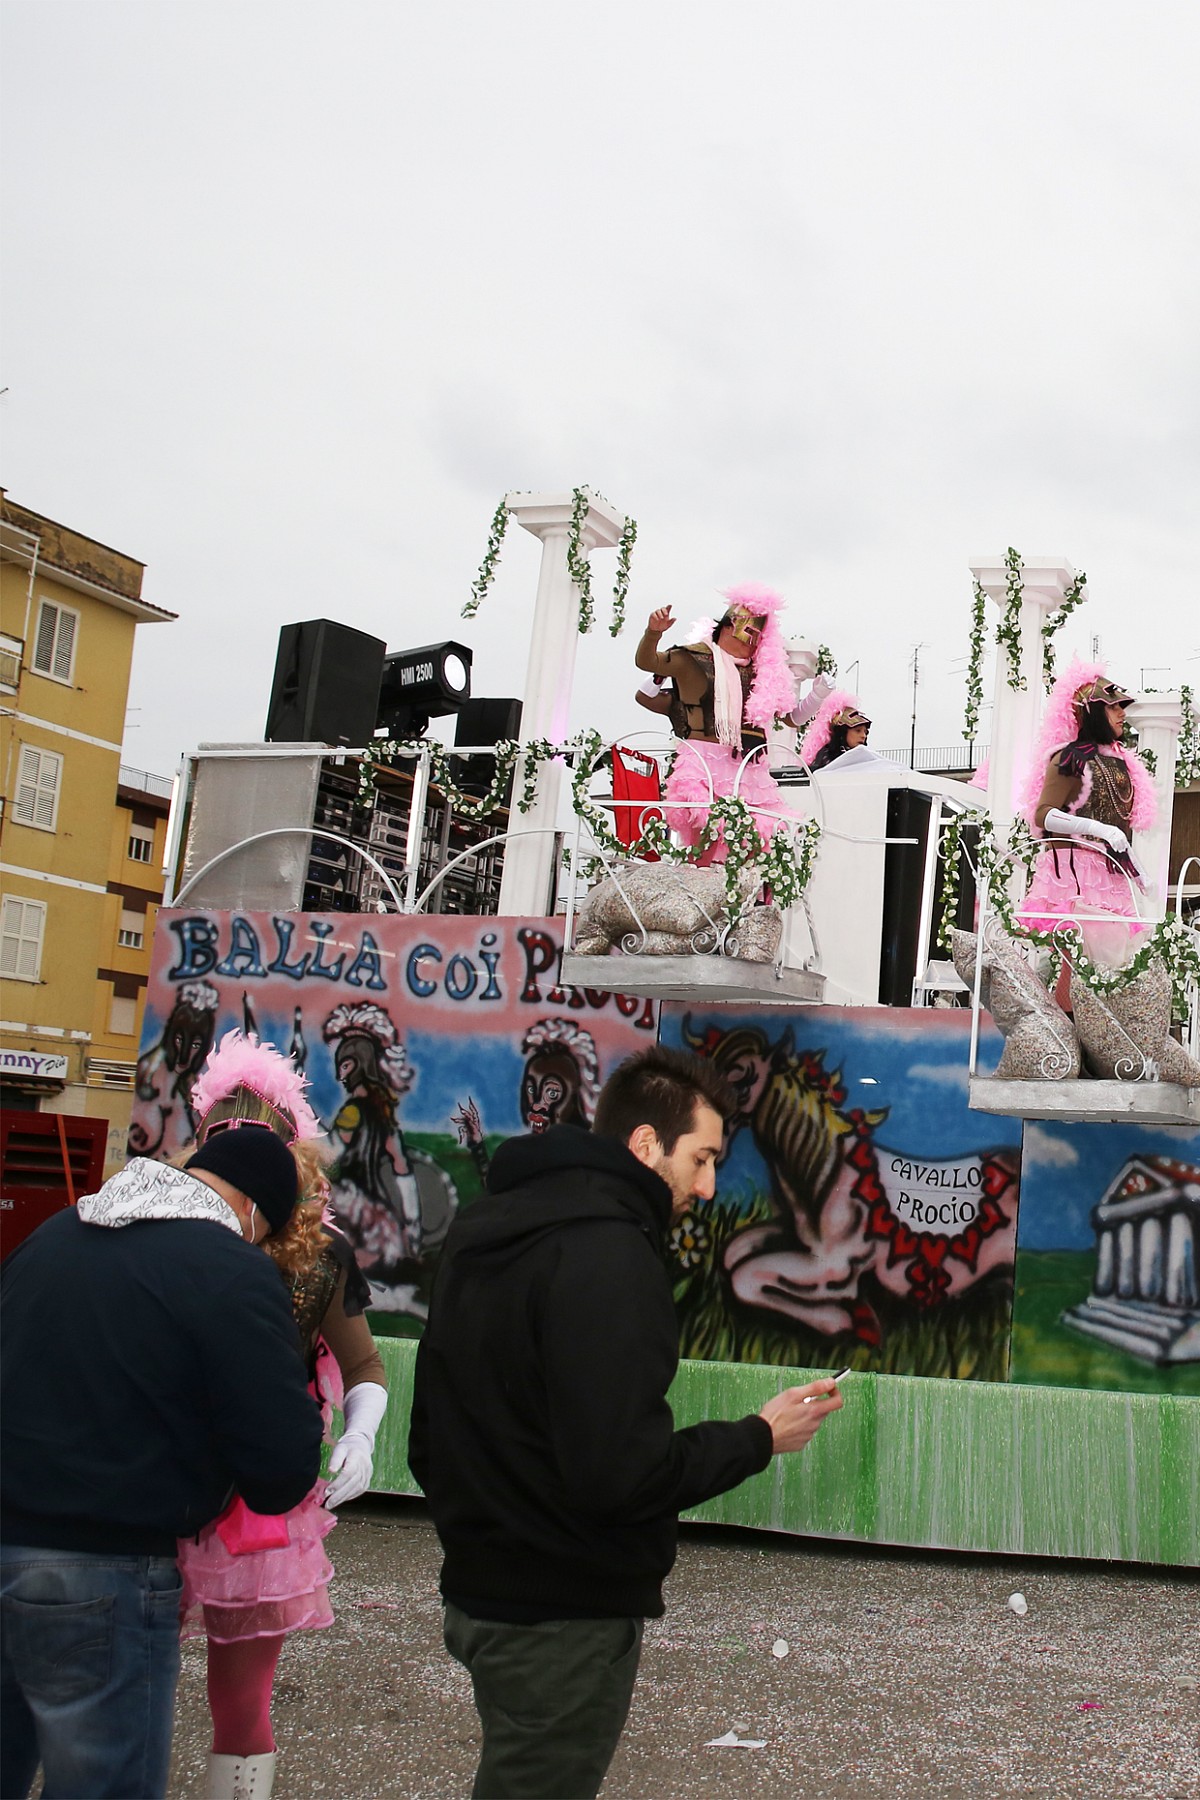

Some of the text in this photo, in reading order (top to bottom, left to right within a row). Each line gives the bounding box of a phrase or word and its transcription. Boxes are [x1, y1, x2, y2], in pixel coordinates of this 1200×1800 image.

[401, 662, 433, 686] HMI 2500
[168, 916, 387, 990] BALLA
[891, 1158, 982, 1188] CAVALLO
